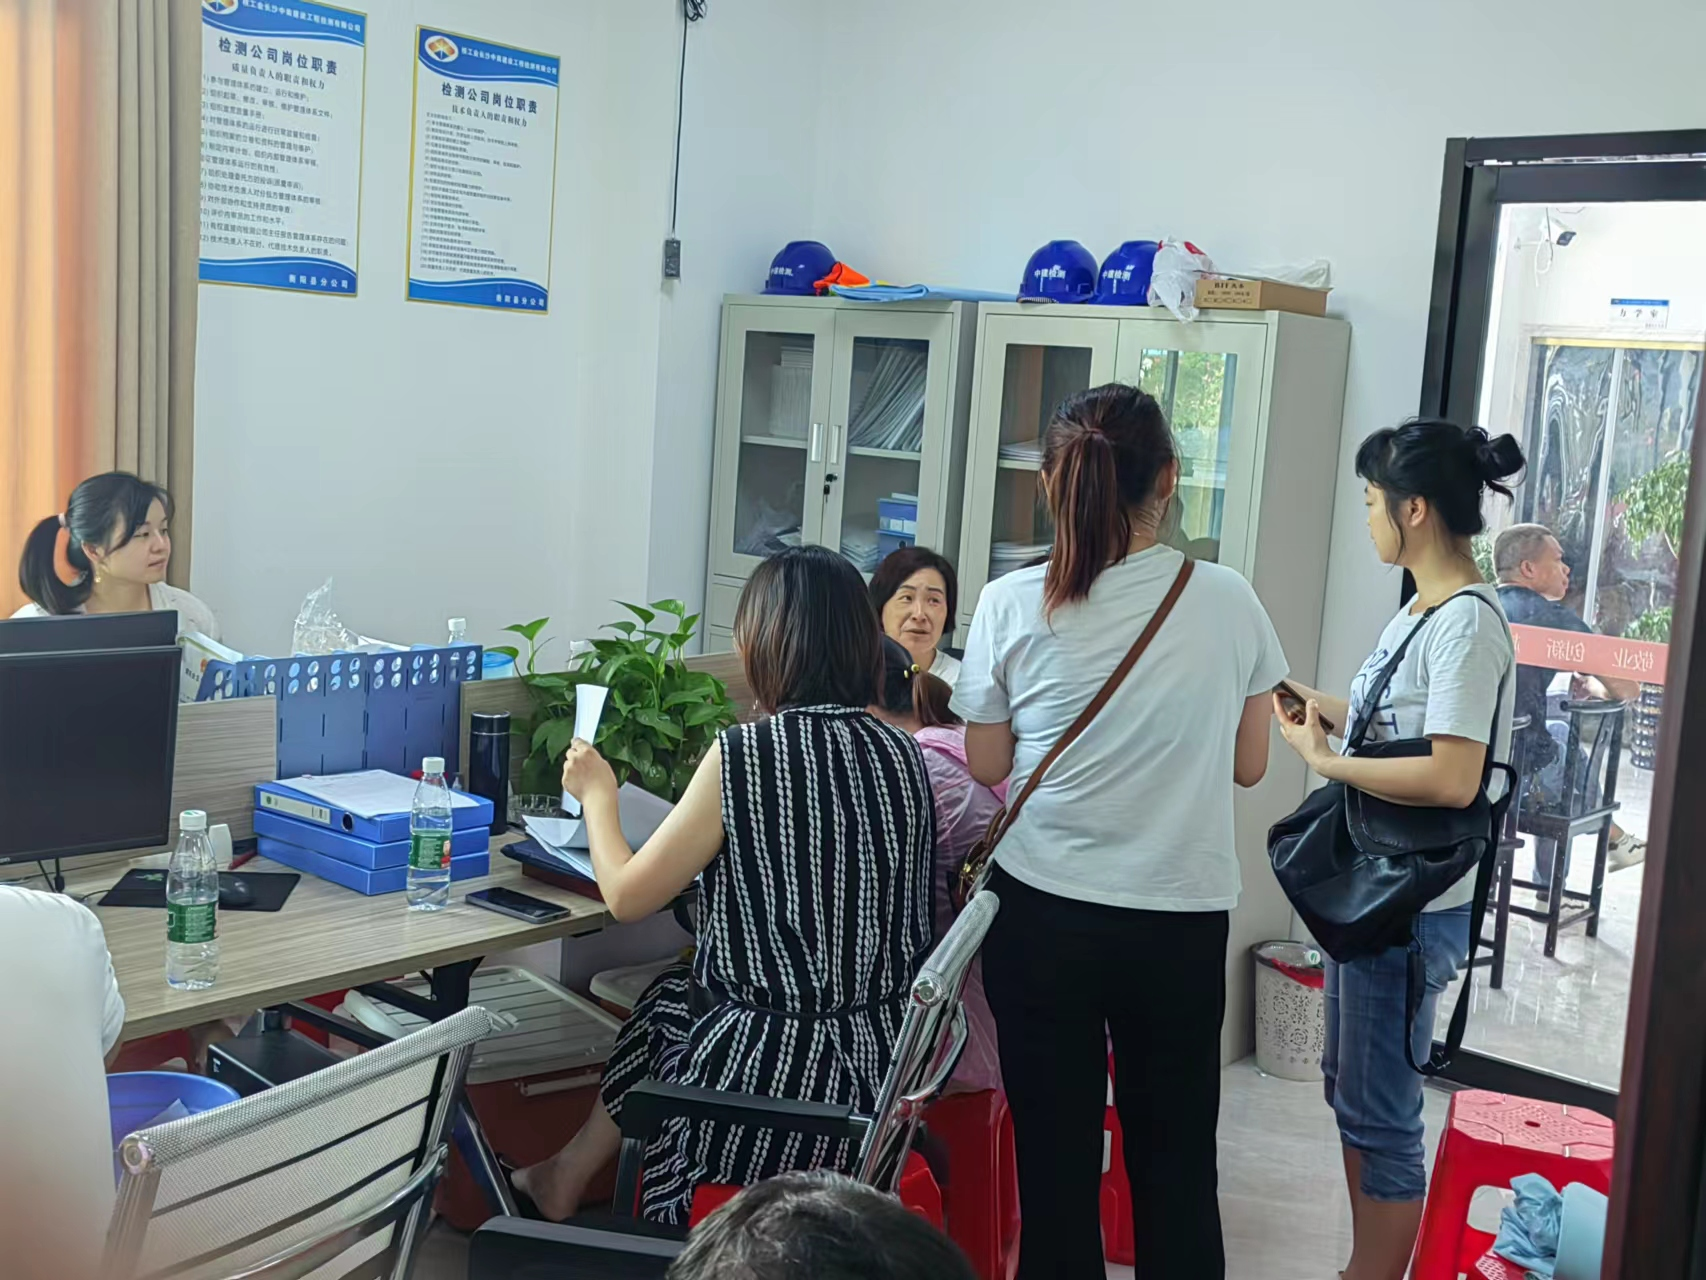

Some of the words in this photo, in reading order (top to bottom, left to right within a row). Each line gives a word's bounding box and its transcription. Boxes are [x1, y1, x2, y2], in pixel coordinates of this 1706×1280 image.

[218, 36, 338, 76] 检测公司岗位职责
[231, 63, 326, 90] 质量负责人的职责和权力
[441, 81, 538, 114] 检测公司岗位职责
